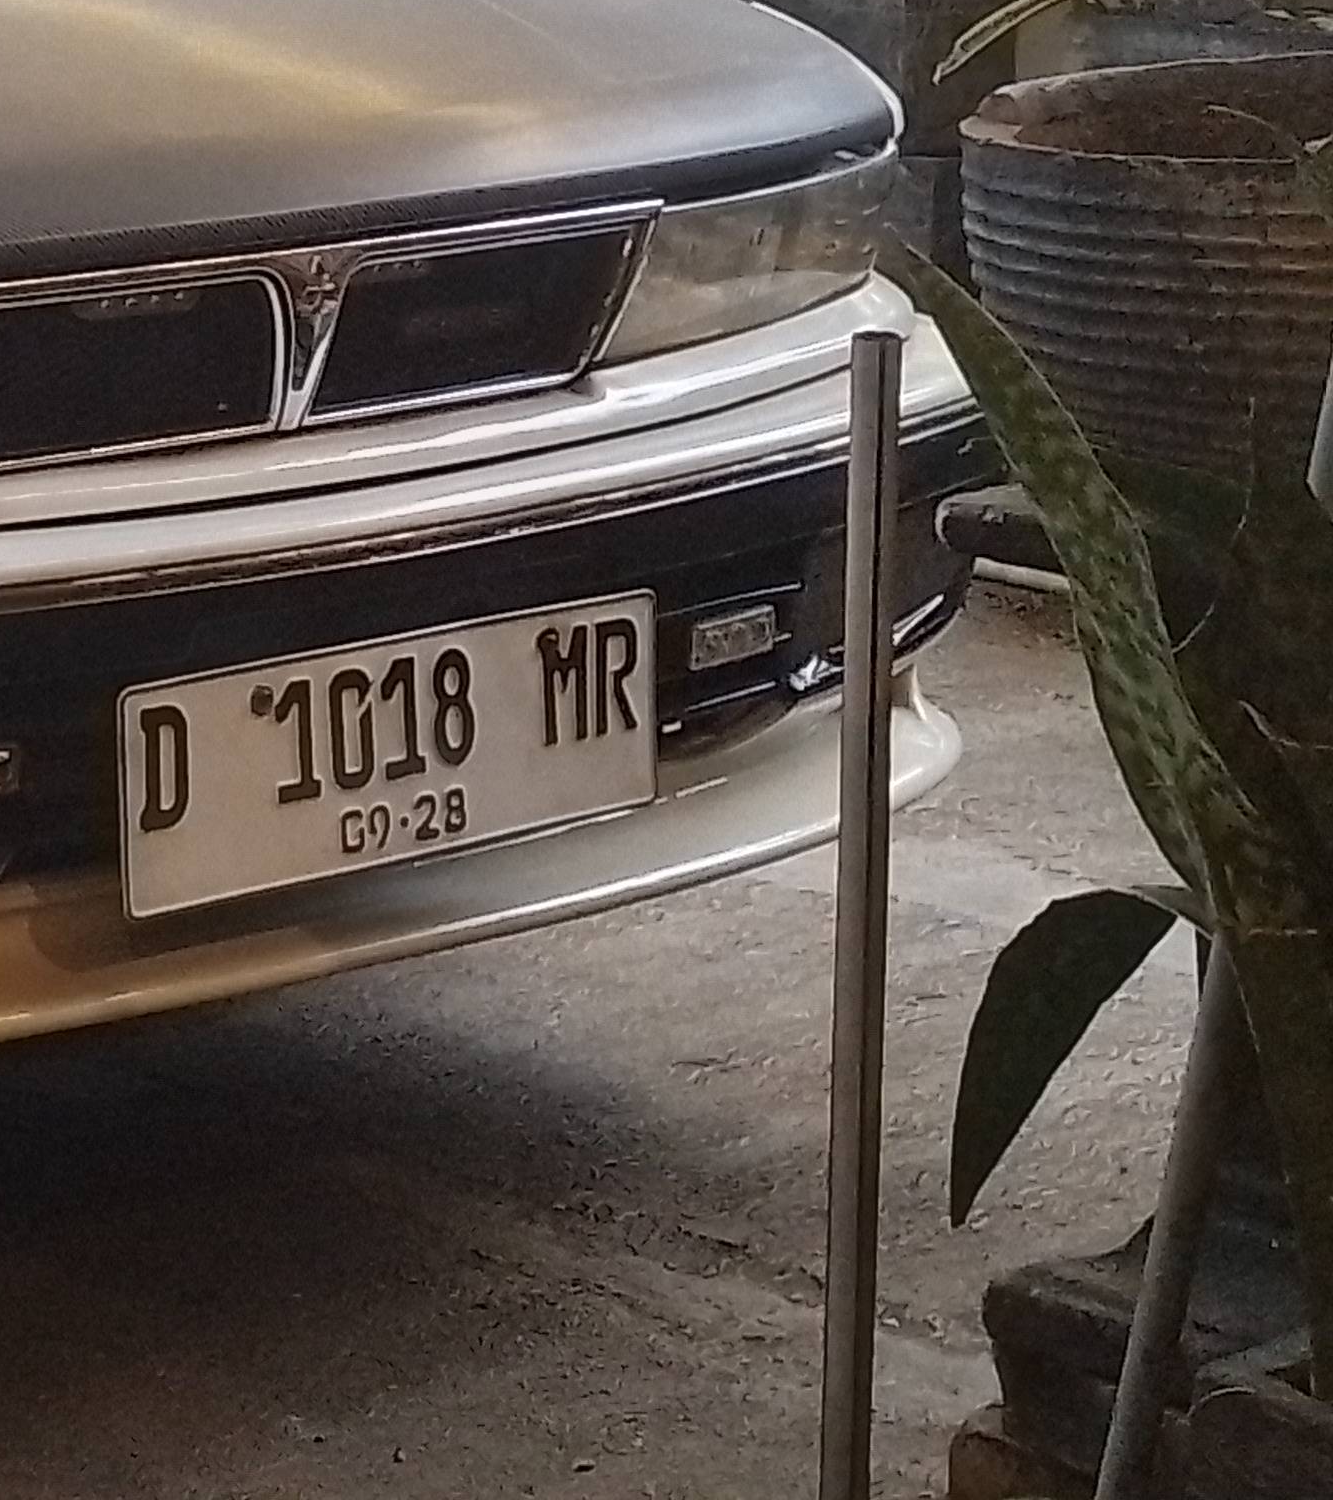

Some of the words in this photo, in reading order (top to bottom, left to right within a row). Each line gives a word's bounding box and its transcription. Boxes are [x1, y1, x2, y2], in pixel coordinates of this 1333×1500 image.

[139, 704, 189, 834] D
[274, 647, 477, 805] 1018
[535, 616, 638, 747] MR
